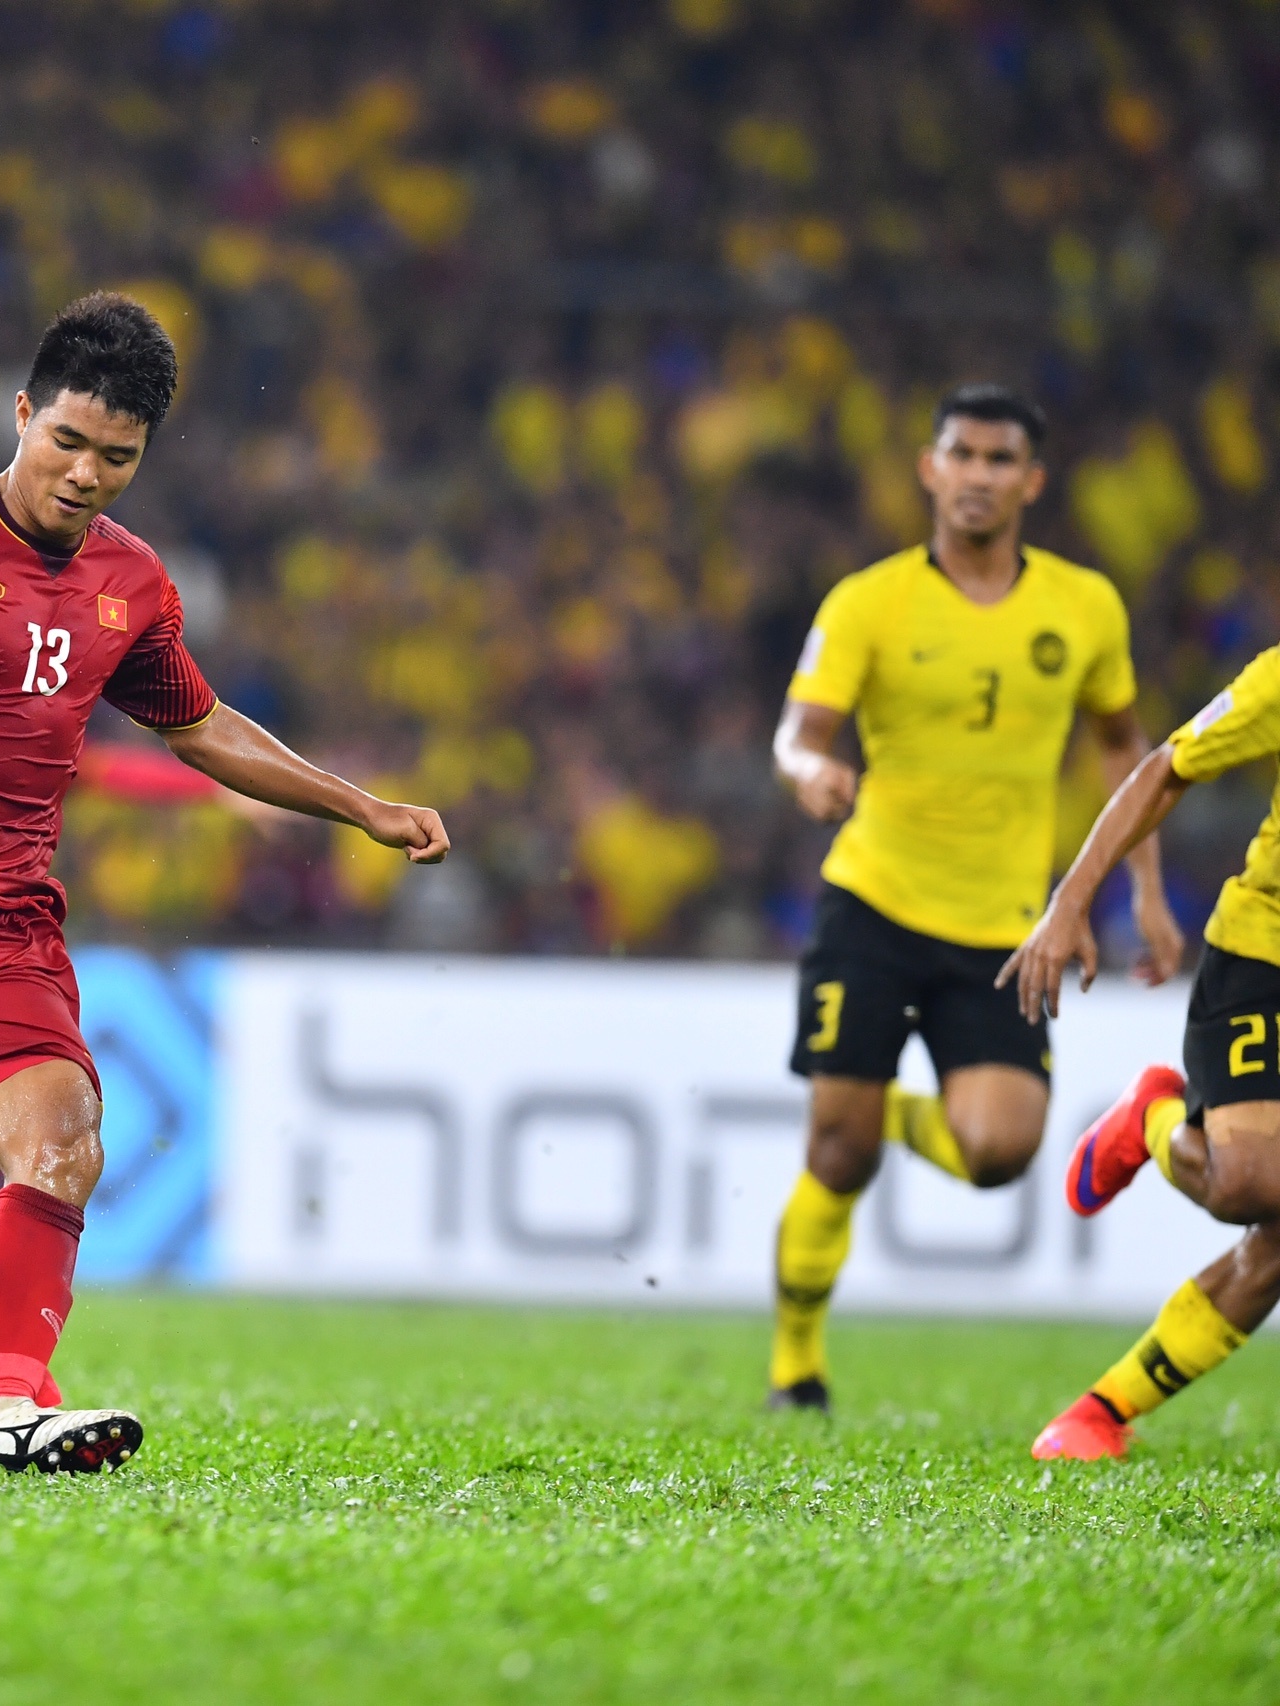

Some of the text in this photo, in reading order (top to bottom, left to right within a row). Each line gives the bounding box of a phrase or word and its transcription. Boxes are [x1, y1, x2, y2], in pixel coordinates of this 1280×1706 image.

[21, 621, 72, 697] 13
[966, 668, 1001, 732] 3
[807, 980, 846, 1053] 3
[1228, 1012, 1280, 1077] 2
